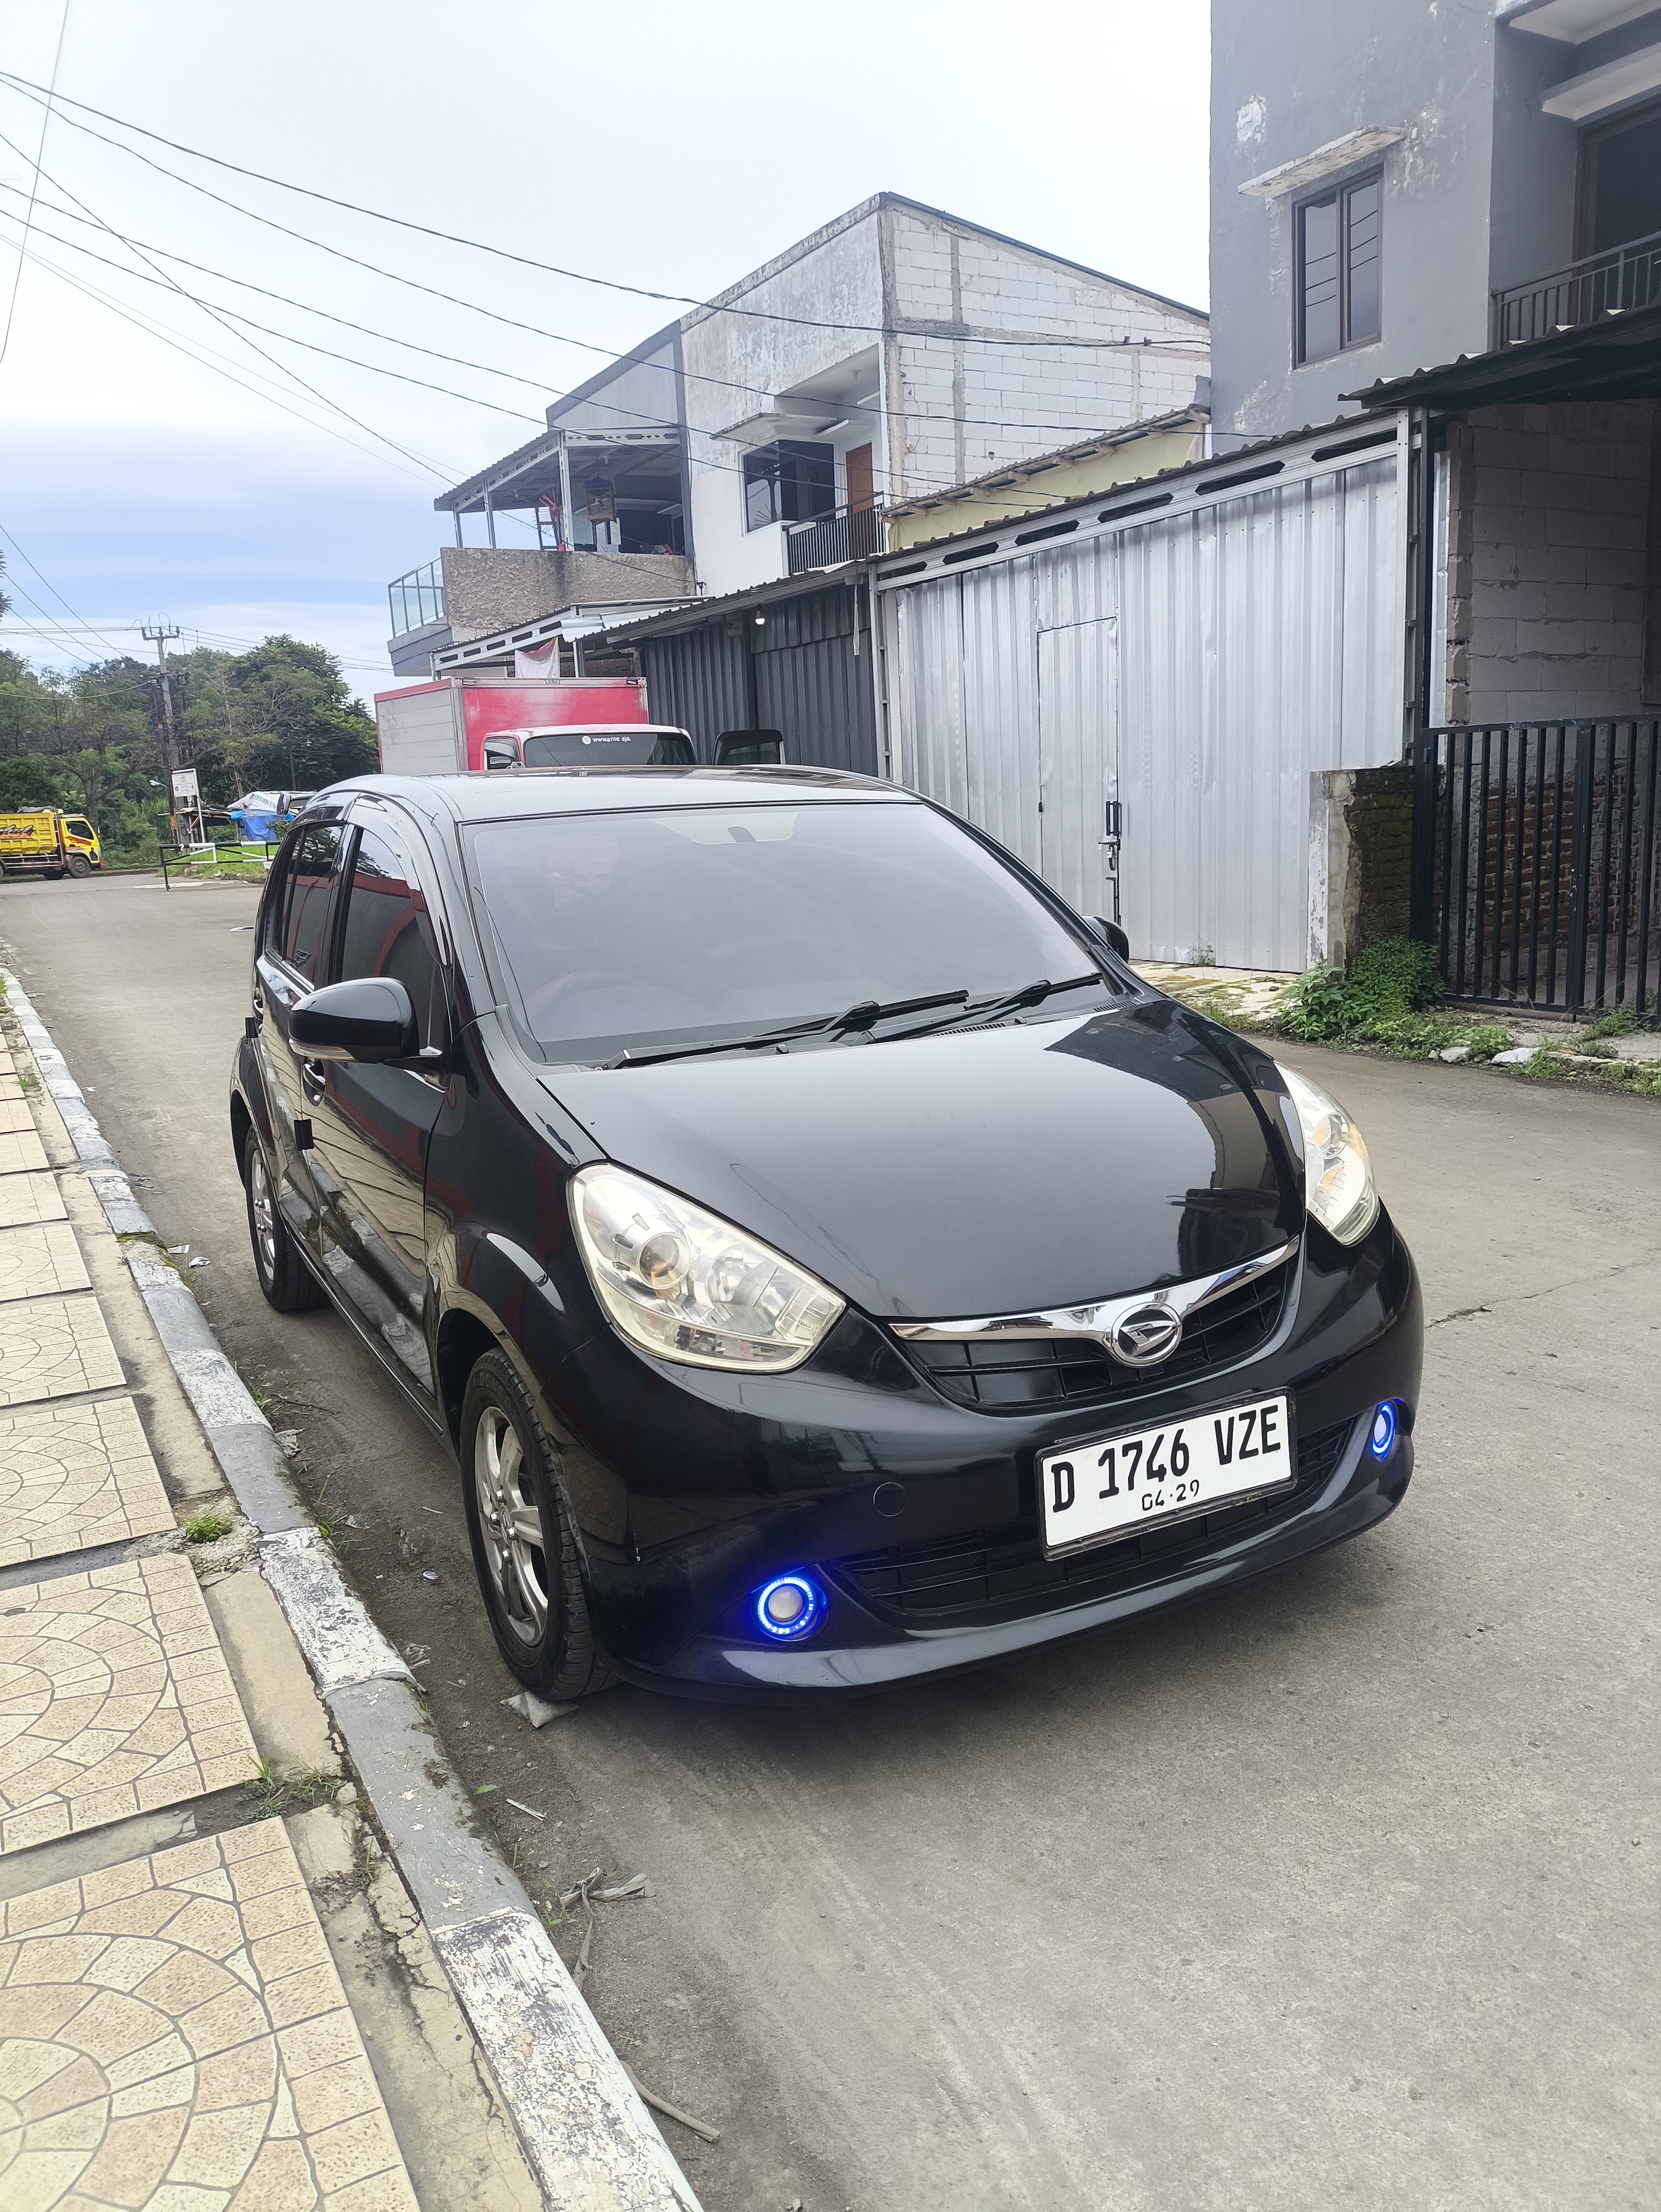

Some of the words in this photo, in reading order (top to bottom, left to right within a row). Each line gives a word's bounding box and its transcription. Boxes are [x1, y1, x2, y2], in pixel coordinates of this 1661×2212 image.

[1051, 1461, 1075, 1513] D
[1098, 1428, 1189, 1499] 1746
[1214, 1405, 1281, 1465] VZE
